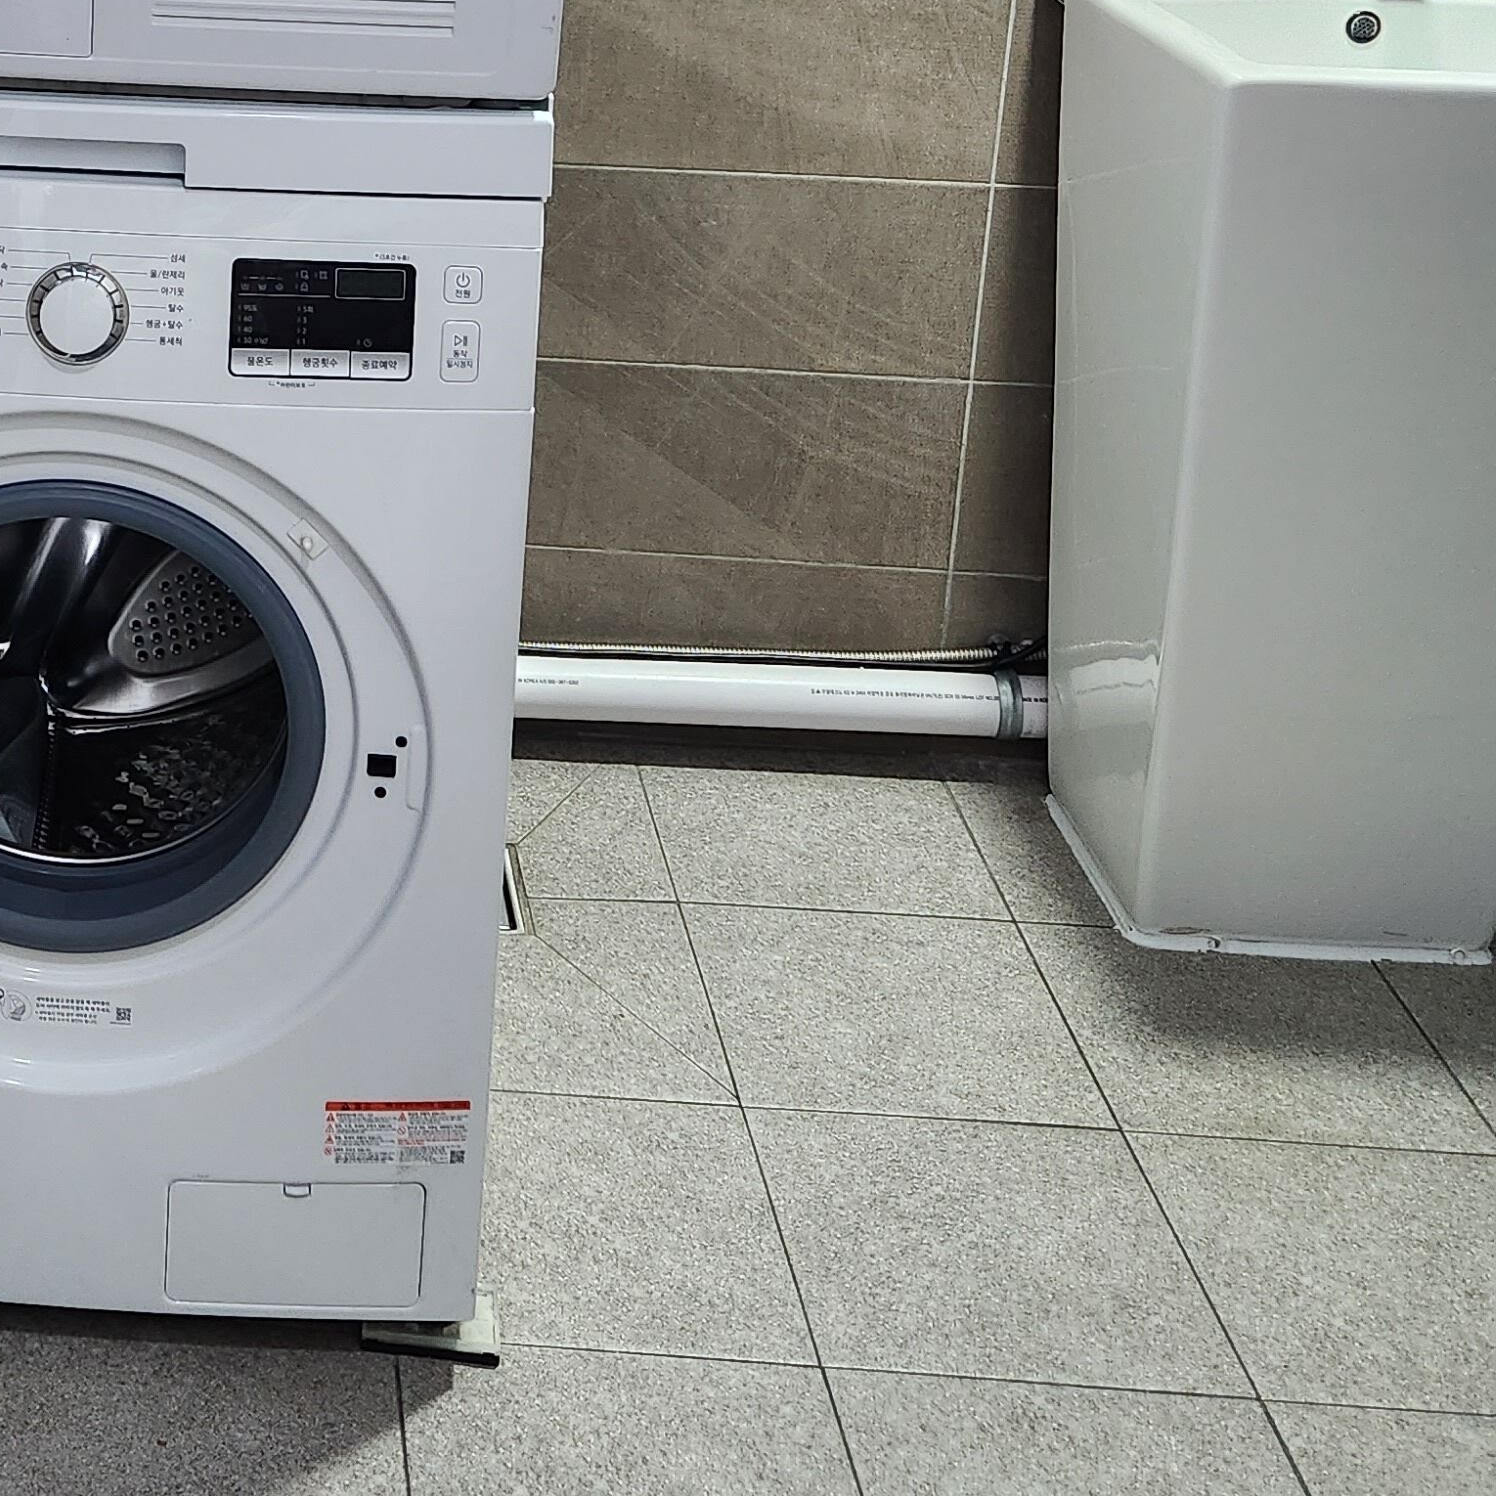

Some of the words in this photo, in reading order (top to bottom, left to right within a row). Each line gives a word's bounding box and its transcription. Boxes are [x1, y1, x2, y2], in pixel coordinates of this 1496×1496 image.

[171, 253, 185, 264] 섬세
[150, 269, 186, 280] 울/란제리
[160, 286, 185, 297] 아기옷
[455, 289, 471, 299] 전원
[168, 303, 184, 313] 탈수
[159, 336, 183, 346] 통세척
[453, 349, 468, 358] 동작
[247, 356, 274, 367] 물온도
[302, 357, 338, 368] 헹굼횟수
[361, 359, 398, 370] 종료예약
